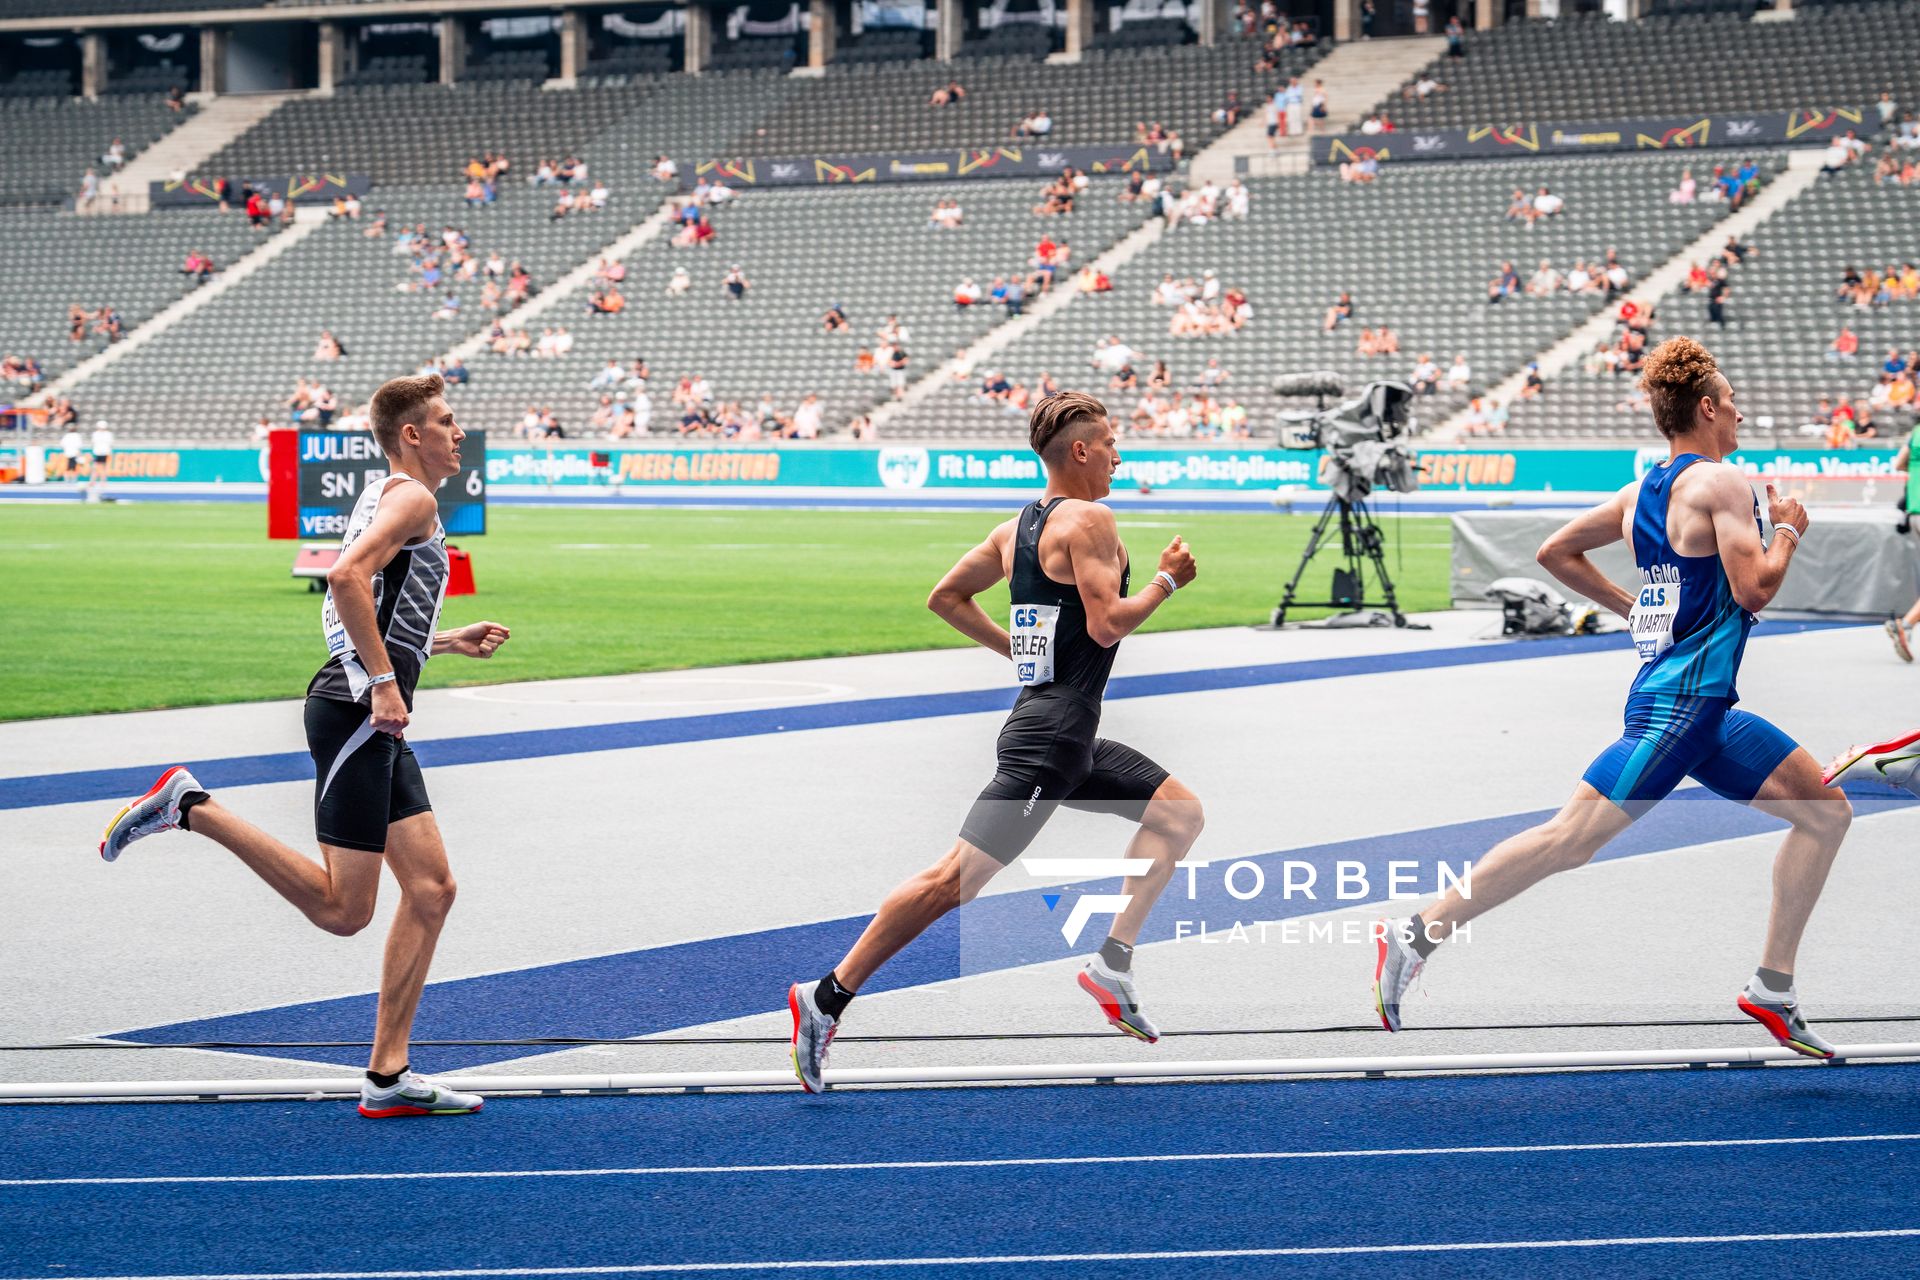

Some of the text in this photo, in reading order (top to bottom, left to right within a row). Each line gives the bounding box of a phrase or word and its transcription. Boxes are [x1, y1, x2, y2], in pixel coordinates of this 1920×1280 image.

[989, 455, 1038, 480] allen
[465, 470, 483, 497] 6
[1636, 613, 1674, 634] MARTIN
[1026, 785, 1042, 812] CRAFT
